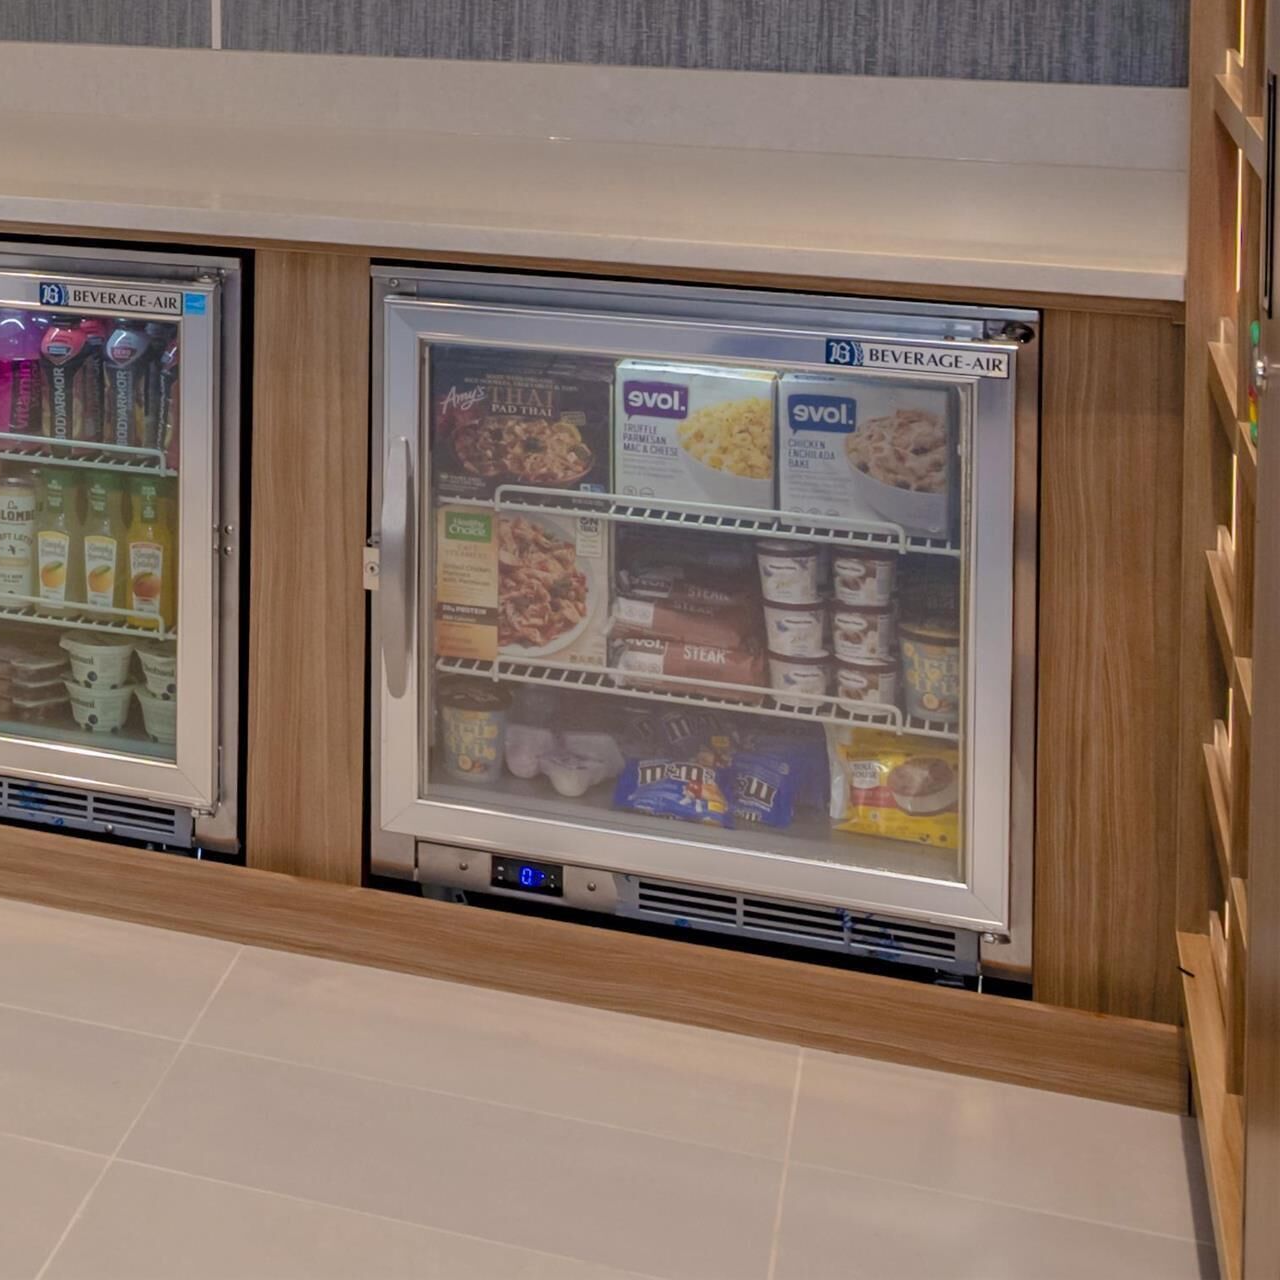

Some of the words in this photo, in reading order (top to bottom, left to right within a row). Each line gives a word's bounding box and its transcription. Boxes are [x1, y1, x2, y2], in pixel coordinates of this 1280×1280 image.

[72, 288, 179, 310] BEVERAGE-AIR
[869, 348, 1003, 371] BEVERAGE-AIR
[441, 385, 487, 414] Amy's
[491, 387, 554, 408] THAI
[491, 403, 517, 416] PAD
[520, 405, 553, 417] THAI
[623, 422, 657, 435] TRUFFLE
[623, 433, 668, 445] PARMESAN
[788, 438, 826, 450] CHICKEN
[623, 443, 640, 454] MAC
[642, 444, 648, 454] &
[649, 445, 679, 457] CHEESE
[788, 449, 836, 461] ENCHILADA
[448, 524, 486, 536] Choice
